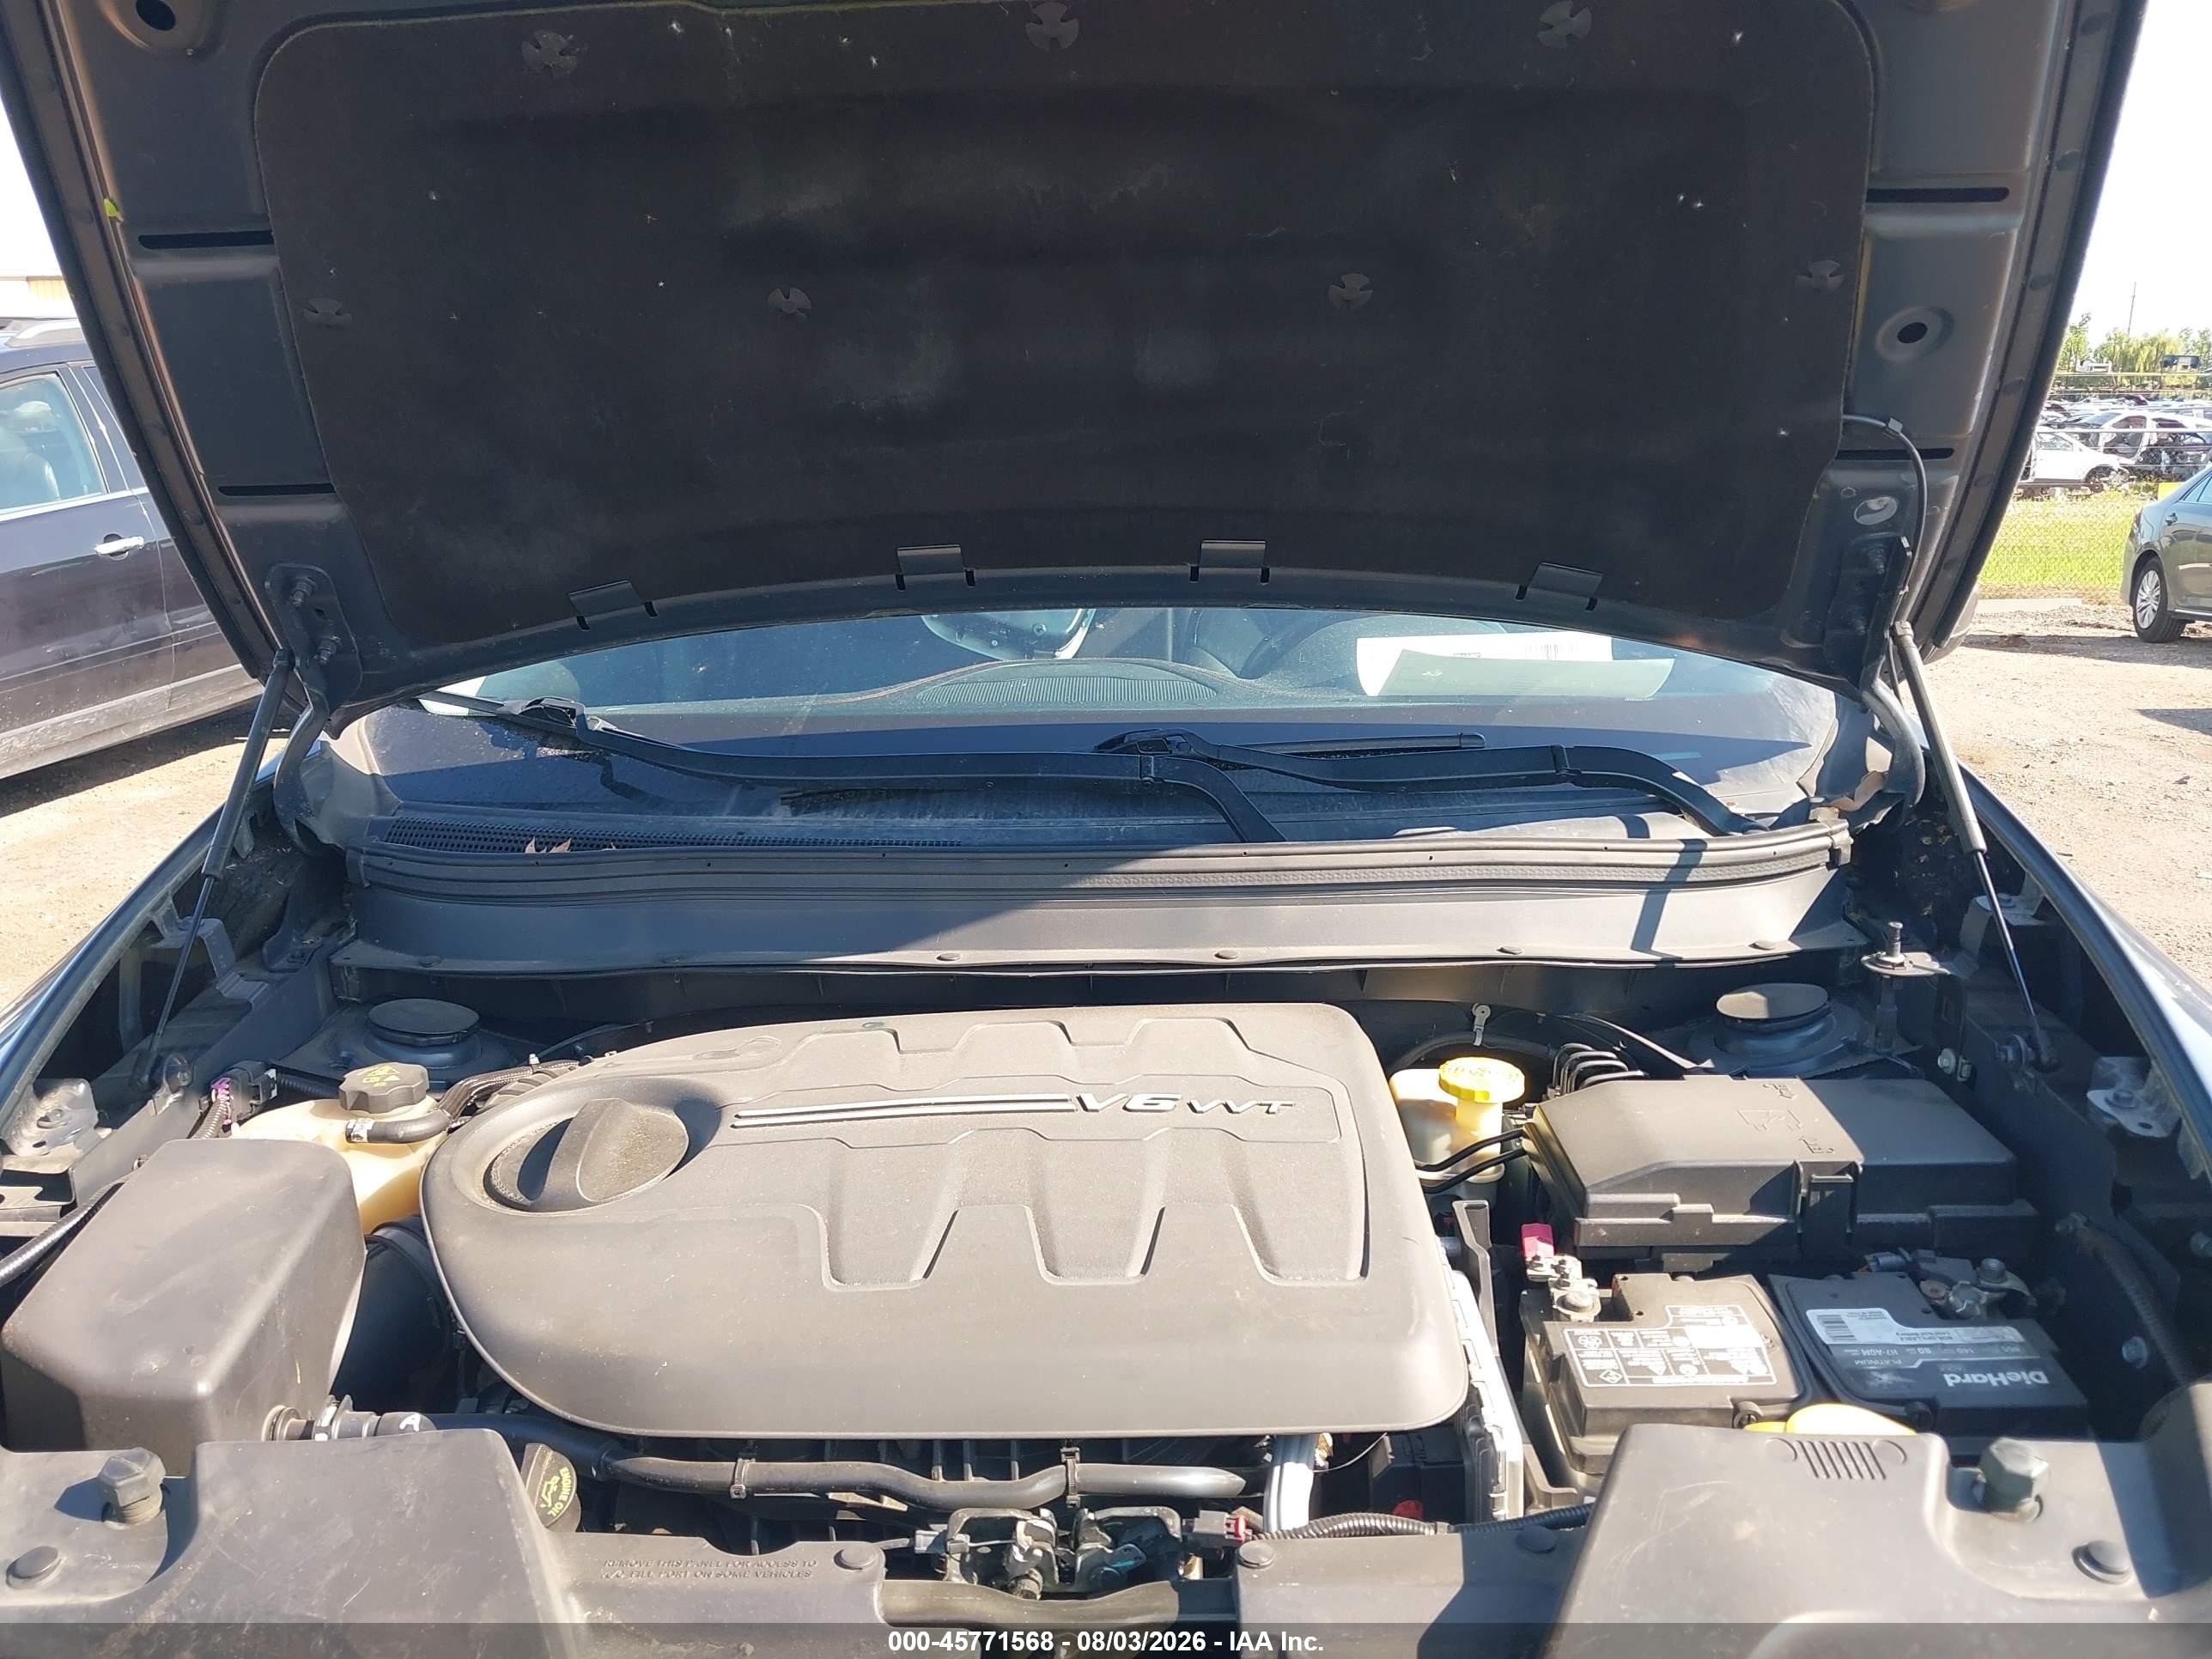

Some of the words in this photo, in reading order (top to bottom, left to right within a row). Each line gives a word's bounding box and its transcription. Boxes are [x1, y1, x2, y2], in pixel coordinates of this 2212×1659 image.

[1076, 1093, 1182, 1112] V6
[1187, 1099, 1295, 1114] VVT
[1943, 1370, 2049, 1387] DieHard
[559, 1467, 571, 1502] ENGINE
[547, 1502, 564, 1516] OIL
